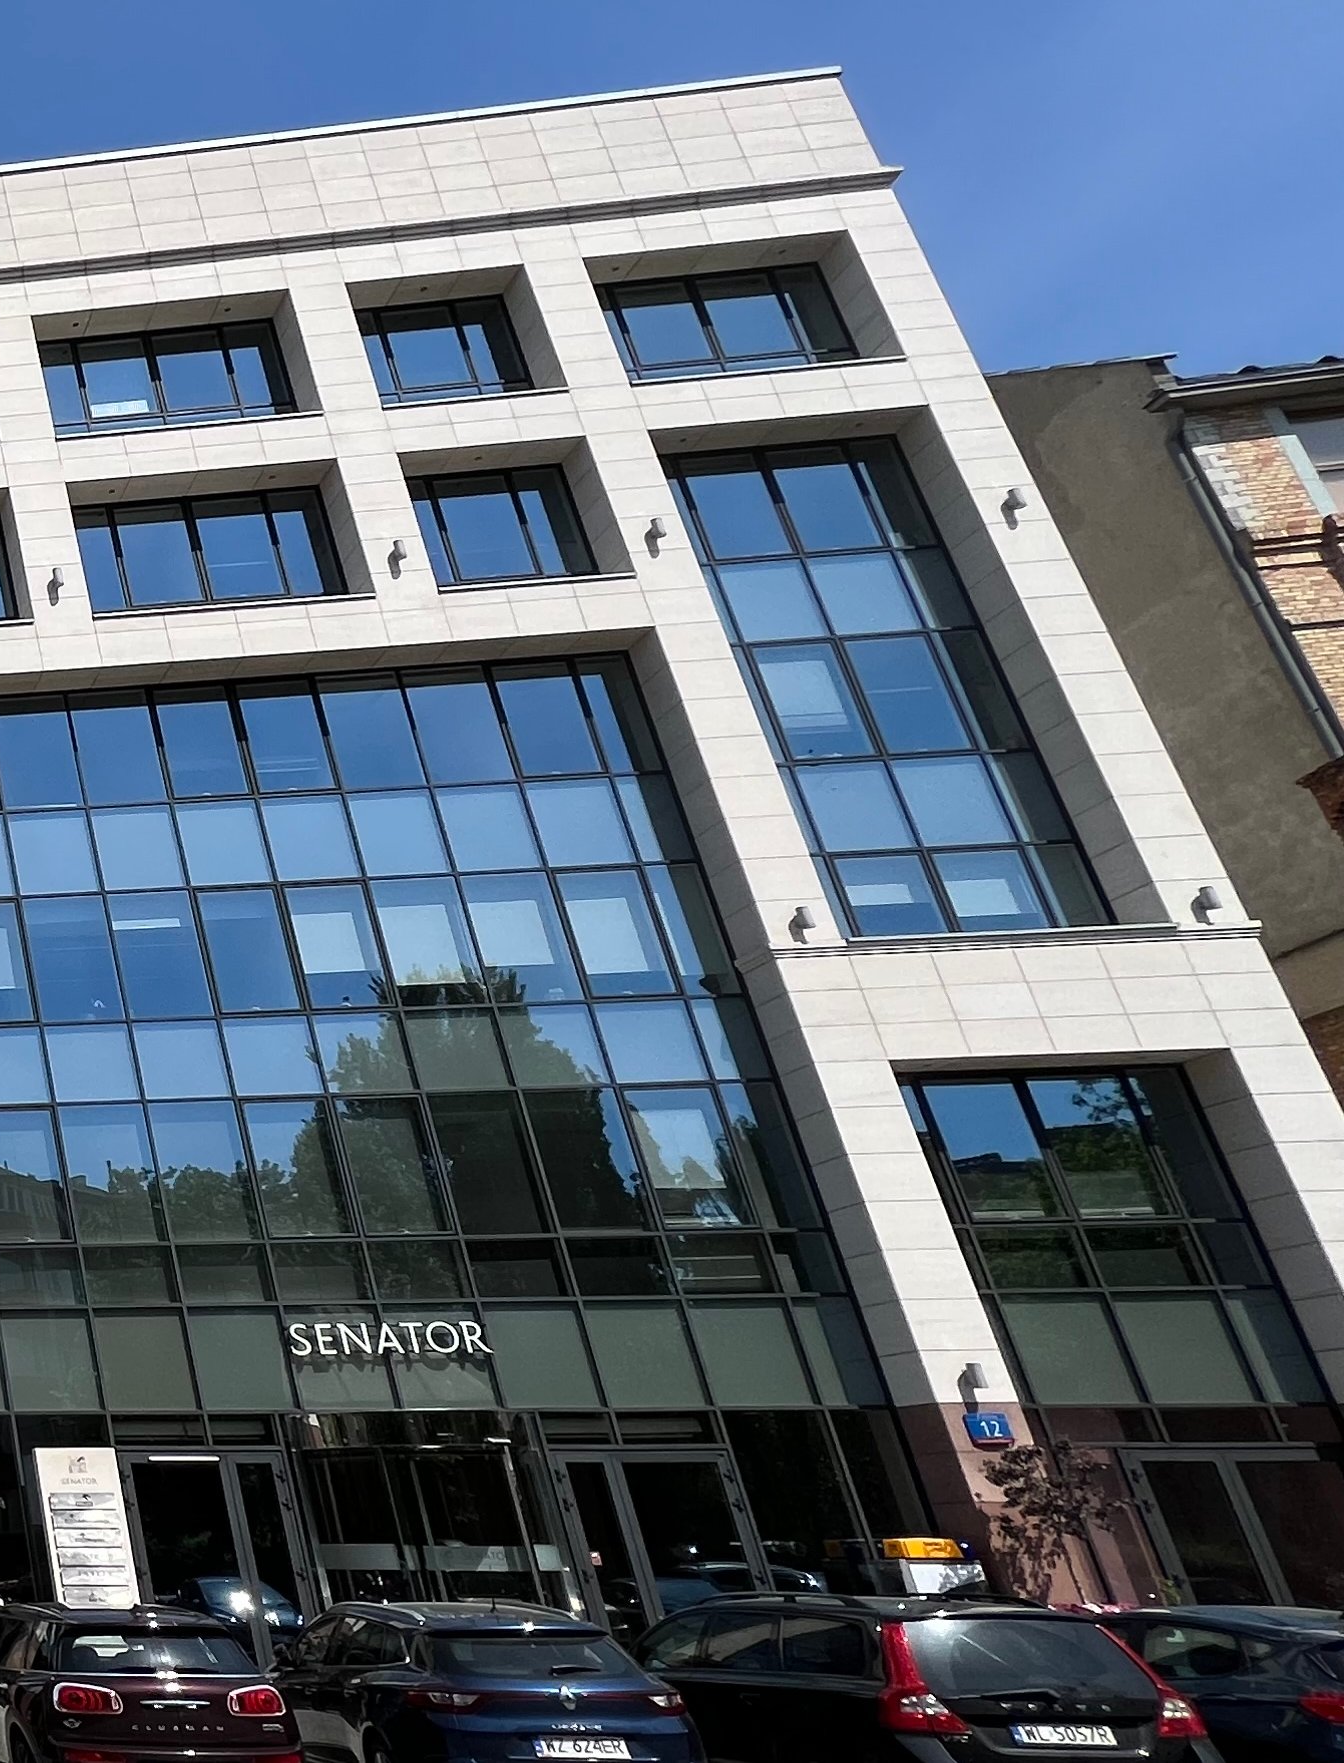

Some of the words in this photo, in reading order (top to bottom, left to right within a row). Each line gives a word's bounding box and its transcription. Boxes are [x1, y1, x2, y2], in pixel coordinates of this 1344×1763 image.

[289, 1320, 494, 1356] SENATOR
[980, 1420, 1004, 1437] 12
[1021, 1726, 1050, 1741] WL
[1055, 1726, 1113, 1744] 5057R
[572, 1737, 625, 1754] 624ER
